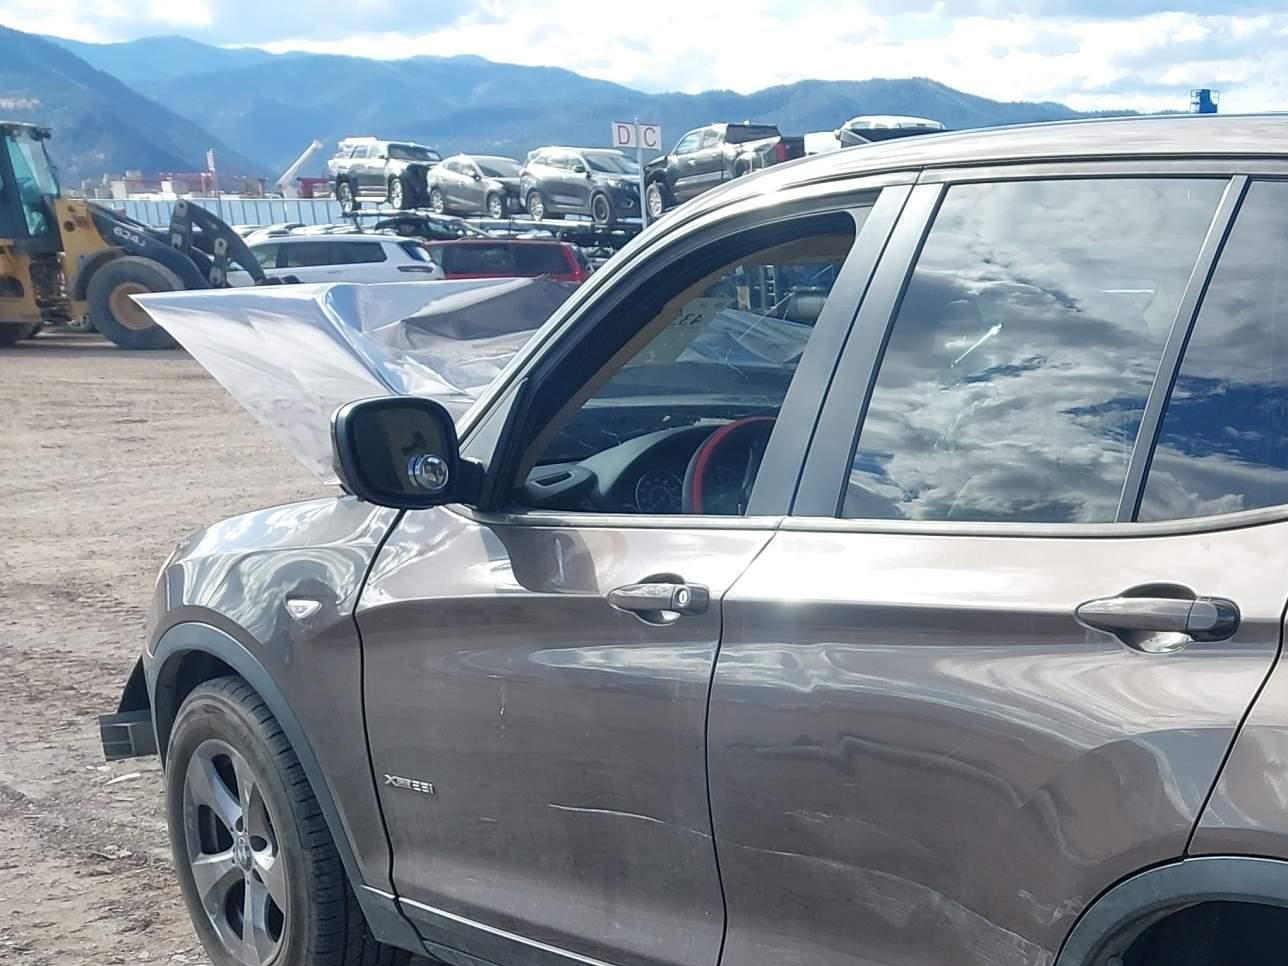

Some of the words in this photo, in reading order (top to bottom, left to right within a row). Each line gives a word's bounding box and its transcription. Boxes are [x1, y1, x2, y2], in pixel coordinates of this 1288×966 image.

[617, 125, 631, 145] D
[643, 127, 657, 147] C
[113, 226, 146, 247] 624J
